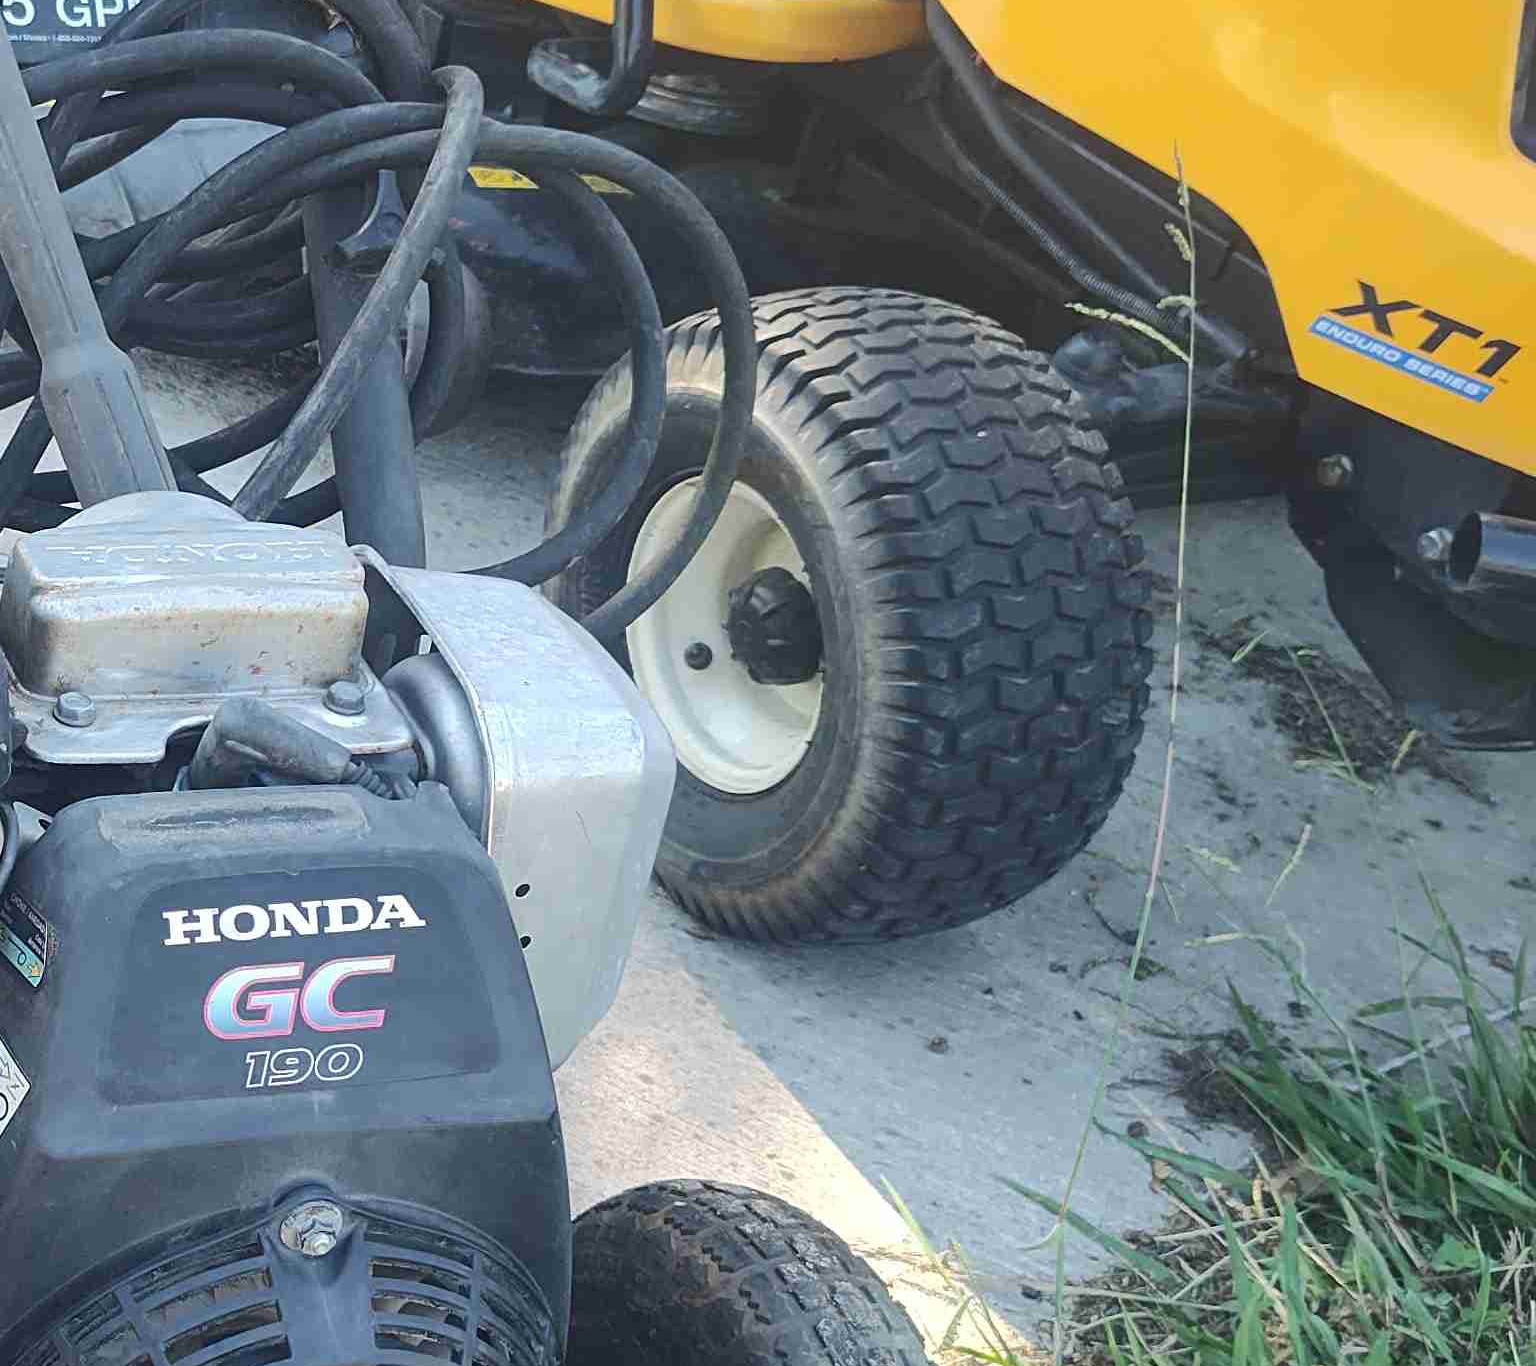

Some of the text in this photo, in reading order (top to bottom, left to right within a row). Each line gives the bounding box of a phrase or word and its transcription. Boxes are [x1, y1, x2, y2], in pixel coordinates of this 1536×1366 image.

[1314, 319, 1483, 397] ENDURO SERIES
[1324, 280, 1521, 378] XT1
[162, 893, 427, 946] HONDA
[202, 954, 396, 1040] GC
[245, 1042, 365, 1089] 190
